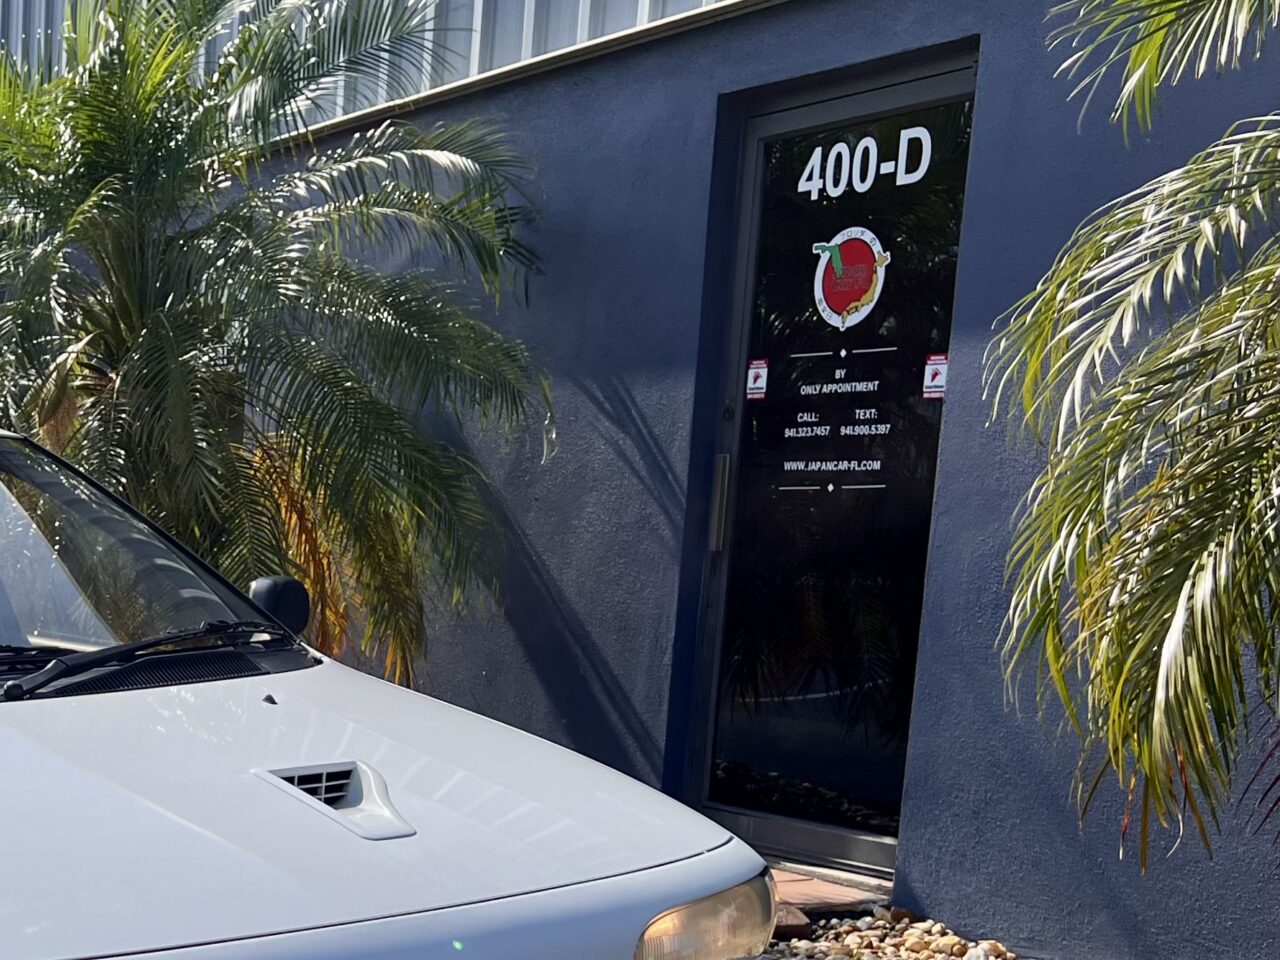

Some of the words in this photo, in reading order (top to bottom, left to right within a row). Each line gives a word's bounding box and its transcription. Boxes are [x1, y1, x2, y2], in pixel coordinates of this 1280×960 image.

[797, 126, 932, 200] 400-D
[835, 368, 846, 379] BY
[800, 384, 821, 395] ONLY
[821, 381, 879, 394] APPOINTMENT
[797, 412, 820, 422] CALL:
[855, 409, 878, 419] TEXT:
[784, 425, 831, 438] 941.323.7457
[840, 424, 891, 436] 941.900.5397
[783, 460, 881, 471] WWW.JAPANCAR-FL.COM
